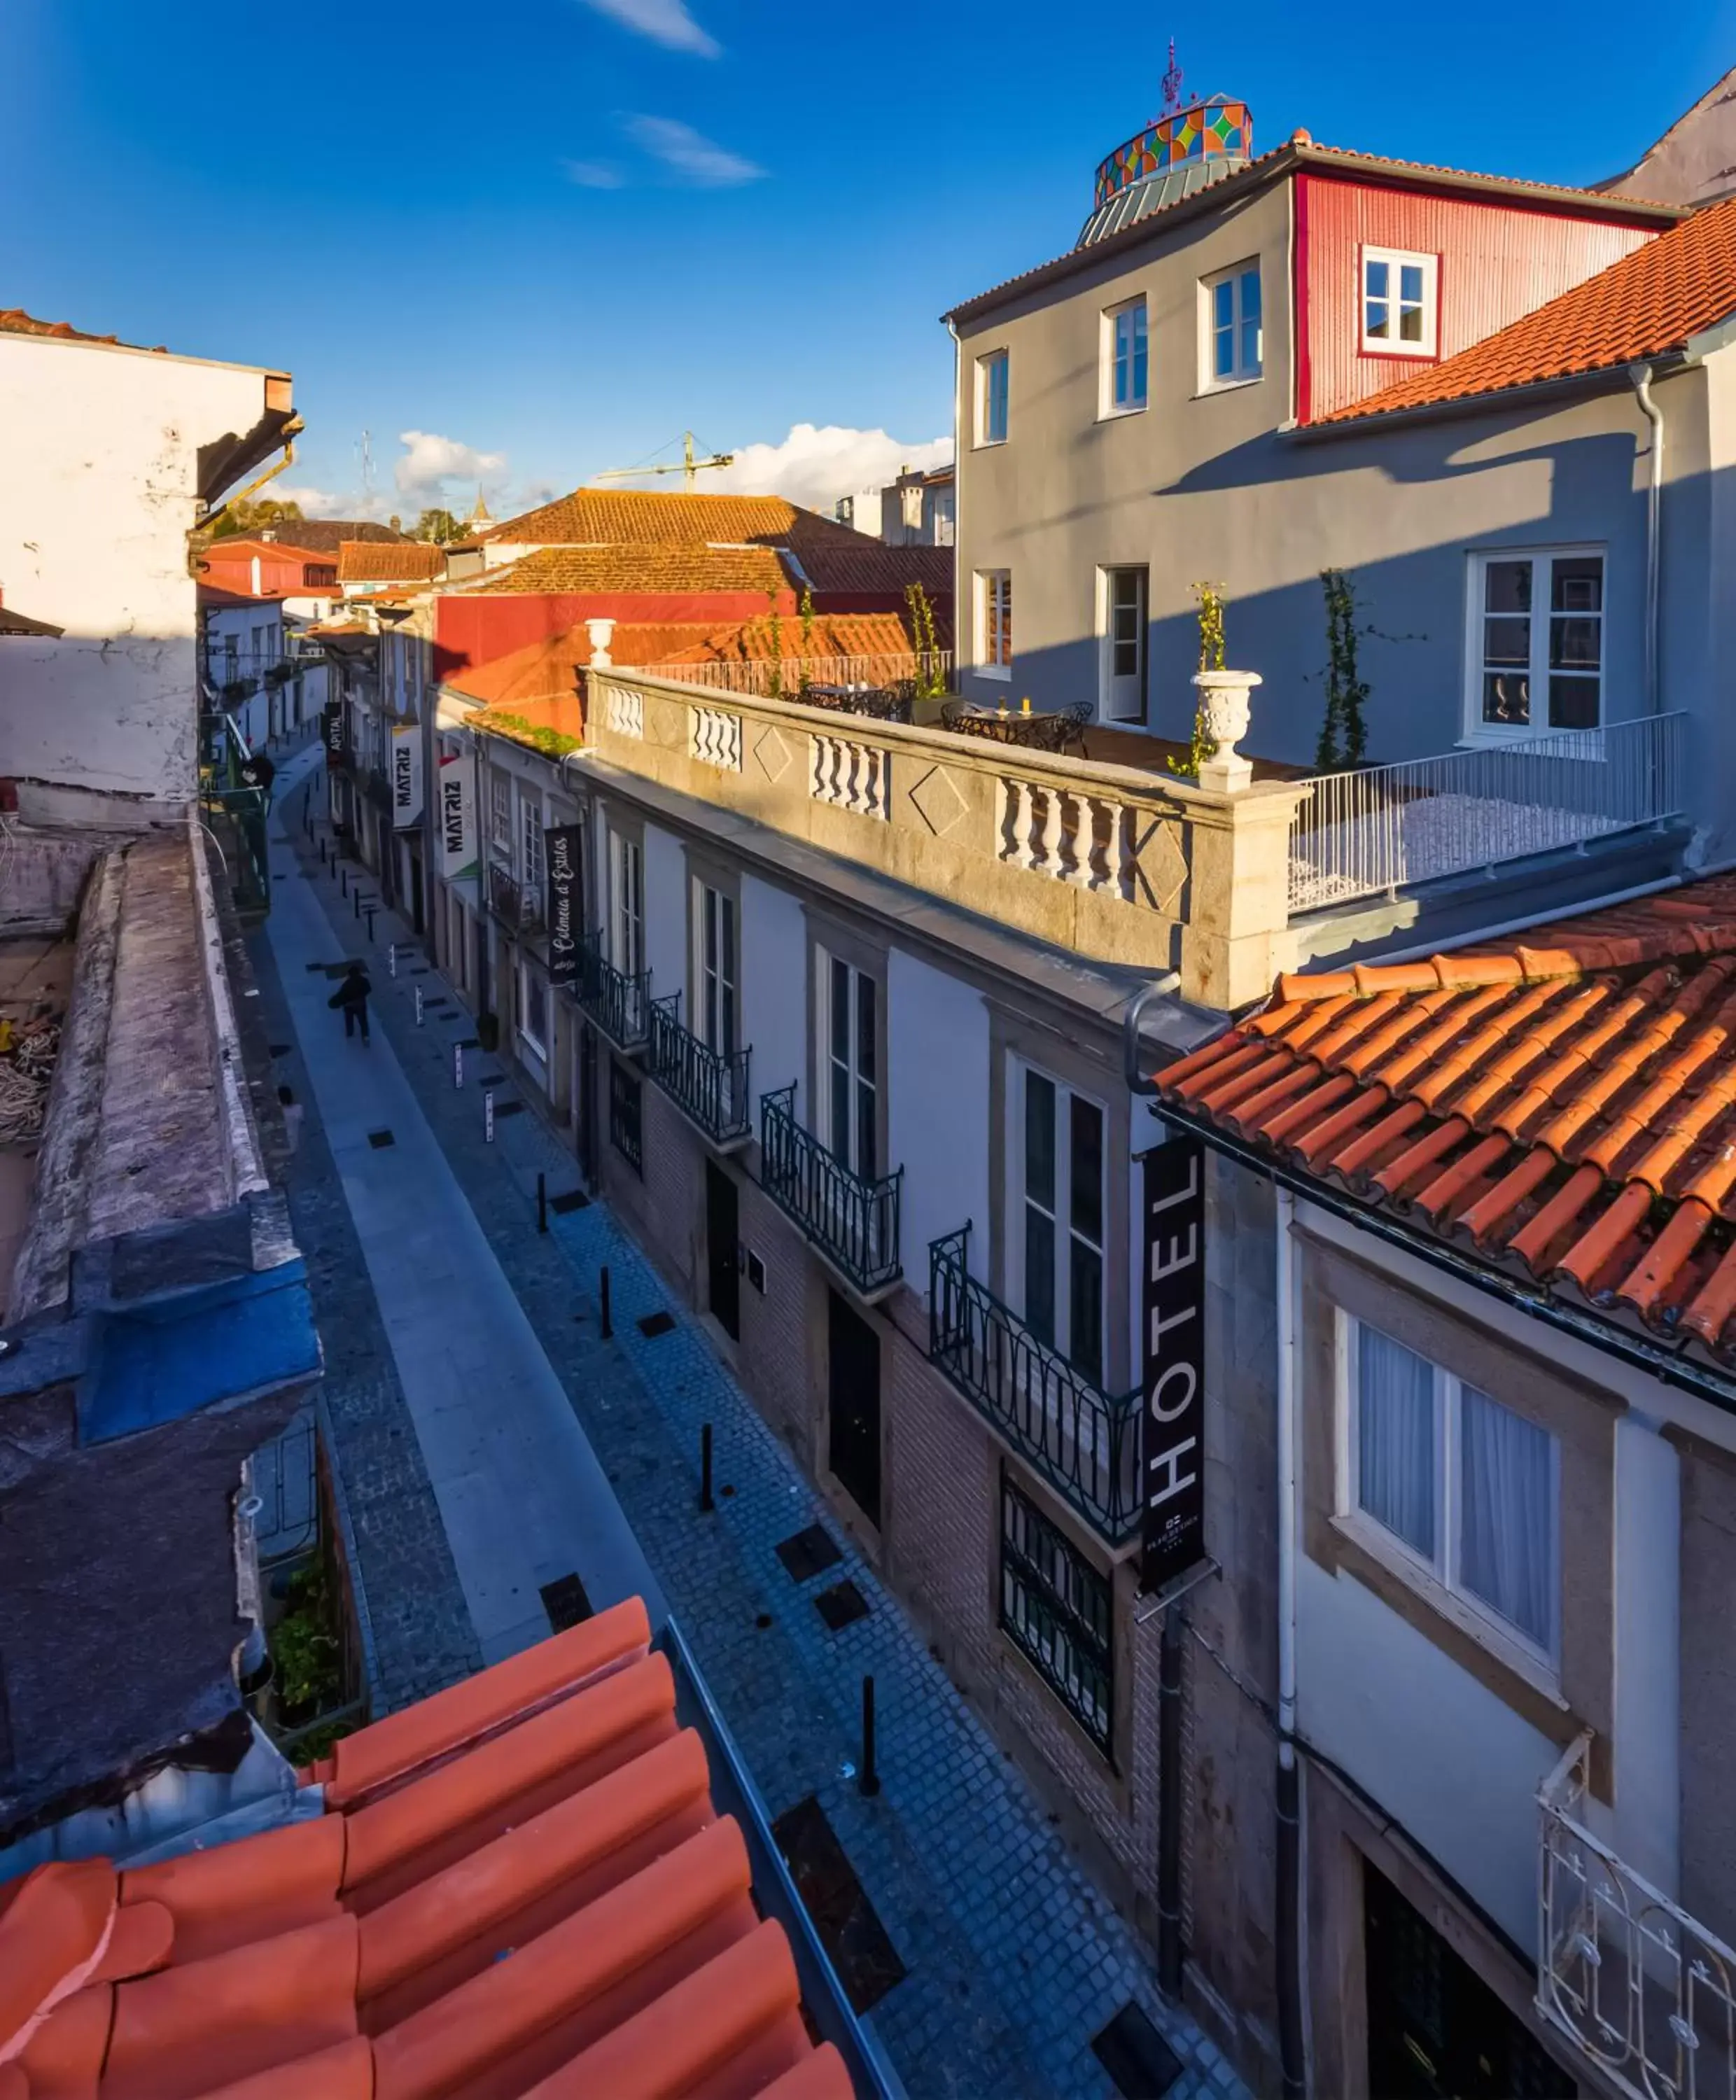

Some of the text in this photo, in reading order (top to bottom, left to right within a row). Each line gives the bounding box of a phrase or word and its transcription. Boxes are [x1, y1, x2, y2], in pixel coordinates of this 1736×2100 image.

[396, 747, 411, 806] MATRIZ
[444, 780, 463, 853] MATRIZ
[1150, 1155, 1196, 1508] HOTEL
